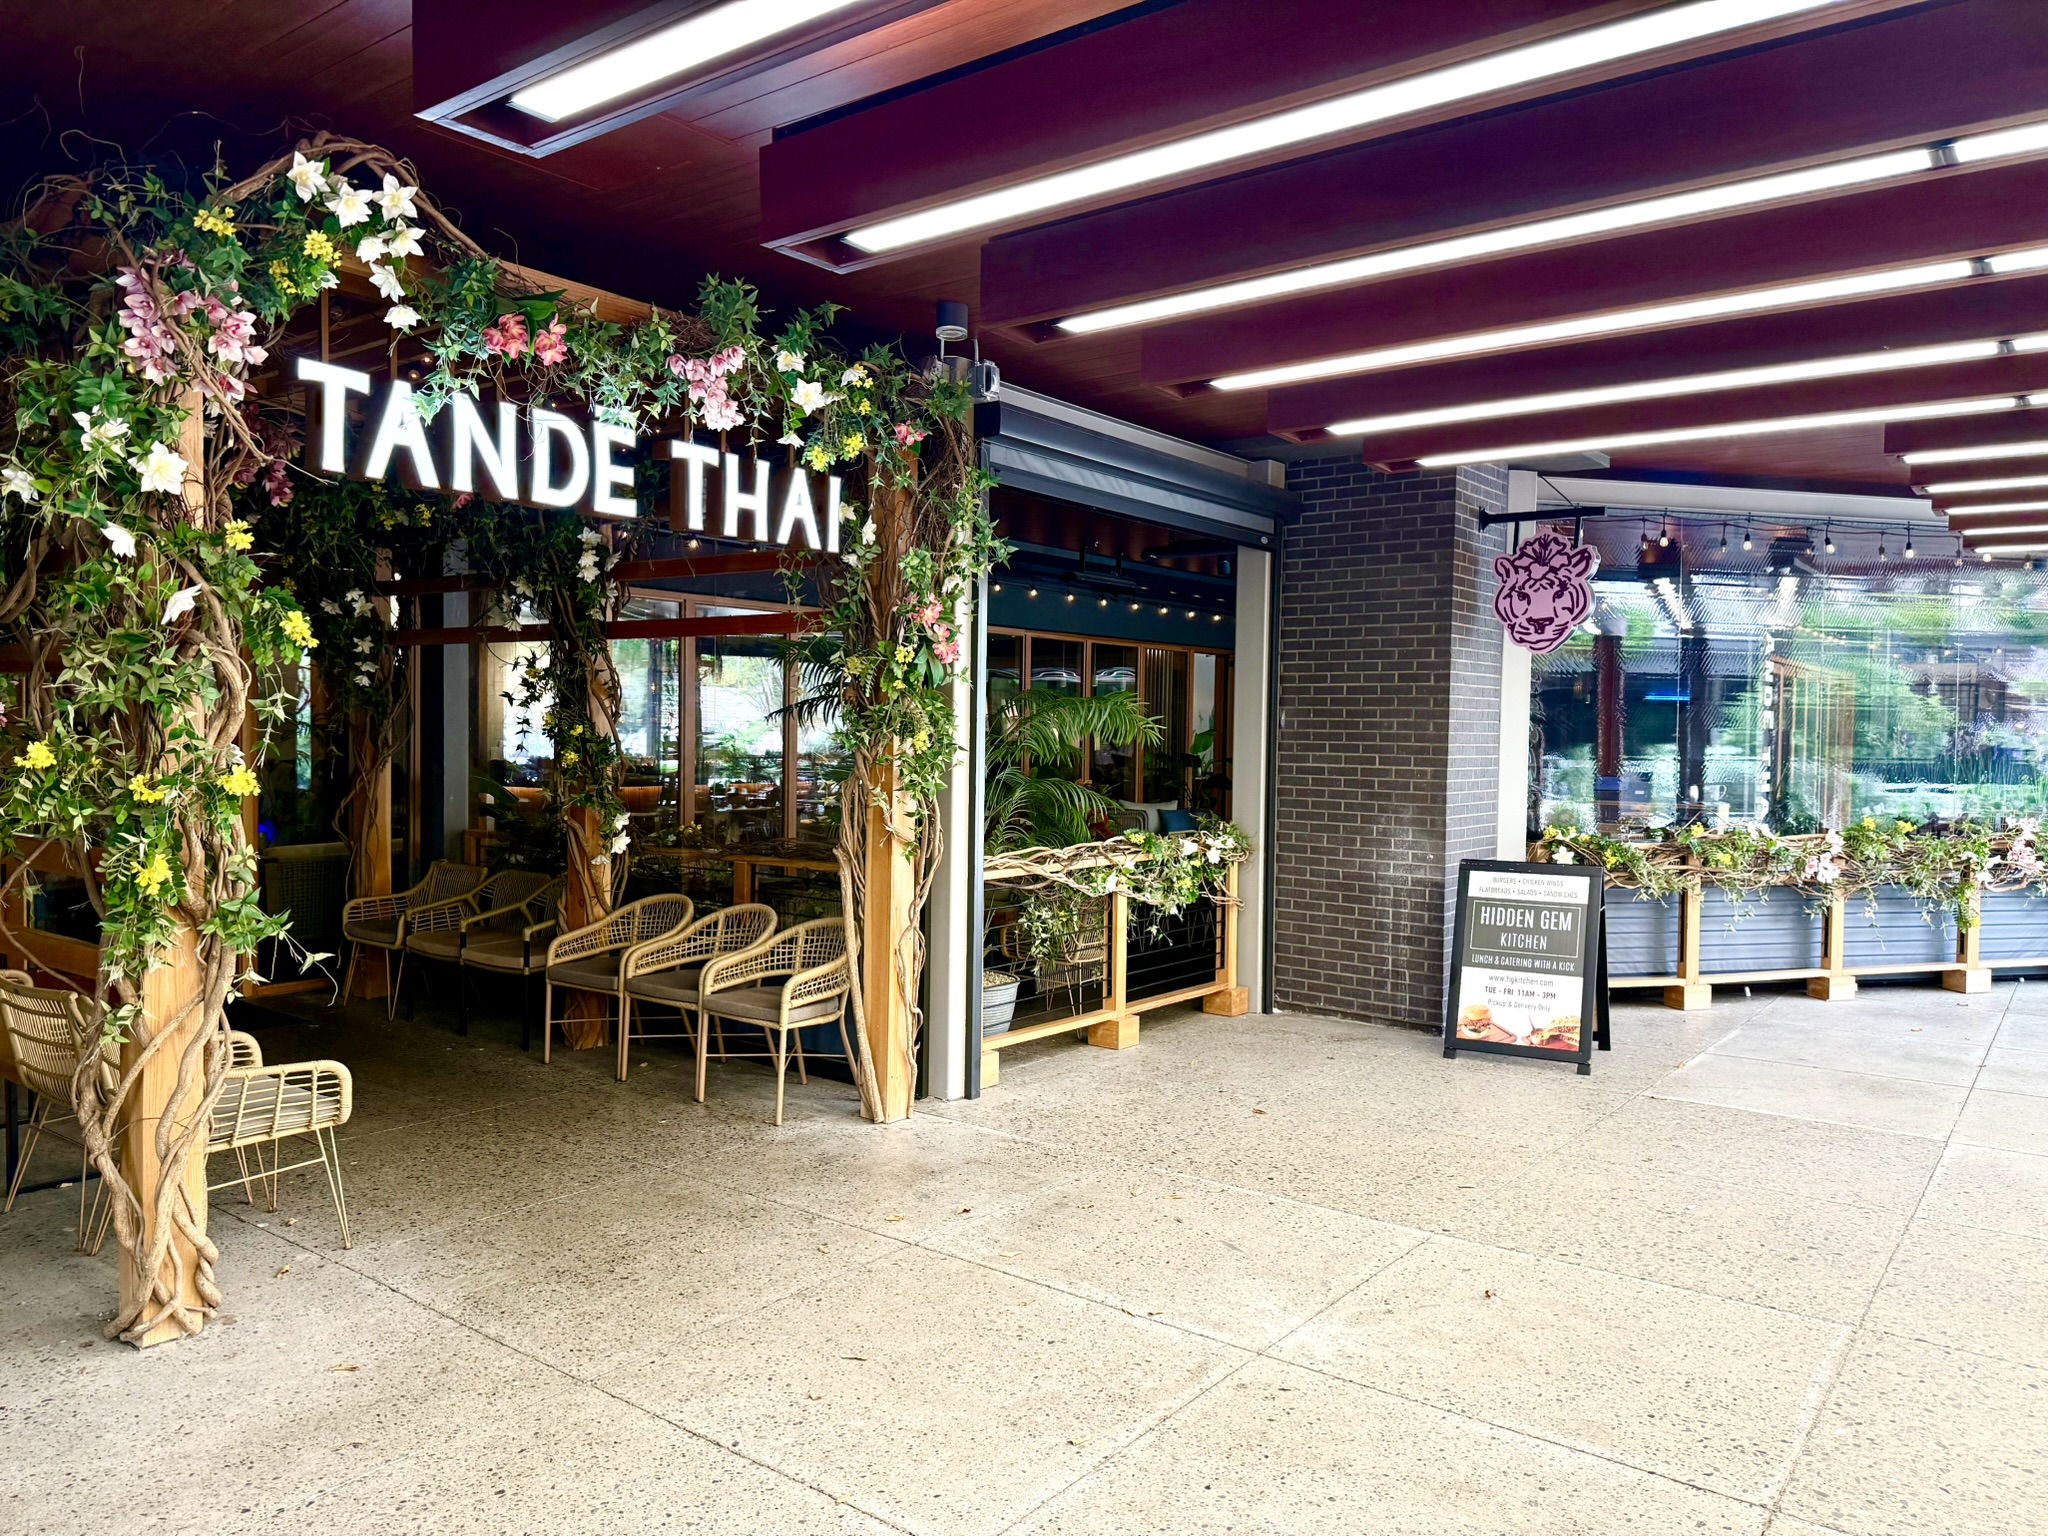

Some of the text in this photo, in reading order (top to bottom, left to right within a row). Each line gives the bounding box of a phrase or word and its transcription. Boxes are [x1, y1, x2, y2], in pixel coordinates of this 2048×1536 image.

[298, 357, 842, 554] TANDE THAI
[1492, 876, 1564, 888] BURGERS CHICKEN WINGS
[1478, 885, 1578, 899] FLATBREADS SALADS SANDWICHES
[1480, 906, 1573, 932] HIDDEN GEM
[1500, 932, 1548, 950] KITCHEN
[1471, 953, 1575, 972] LUNCH & CATERING WITH A KICK
[1488, 974, 1554, 987] www.hgkitchen.com
[1485, 986, 1497, 994] TUE
[1503, 987, 1514, 995] FRI
[1517, 989, 1535, 998] 11AM
[1541, 991, 1556, 1000] 3PM
[1487, 998, 1506, 1008] Pickup
[1513, 1001, 1537, 1011] Delivery
[1538, 1003, 1551, 1013] Only
